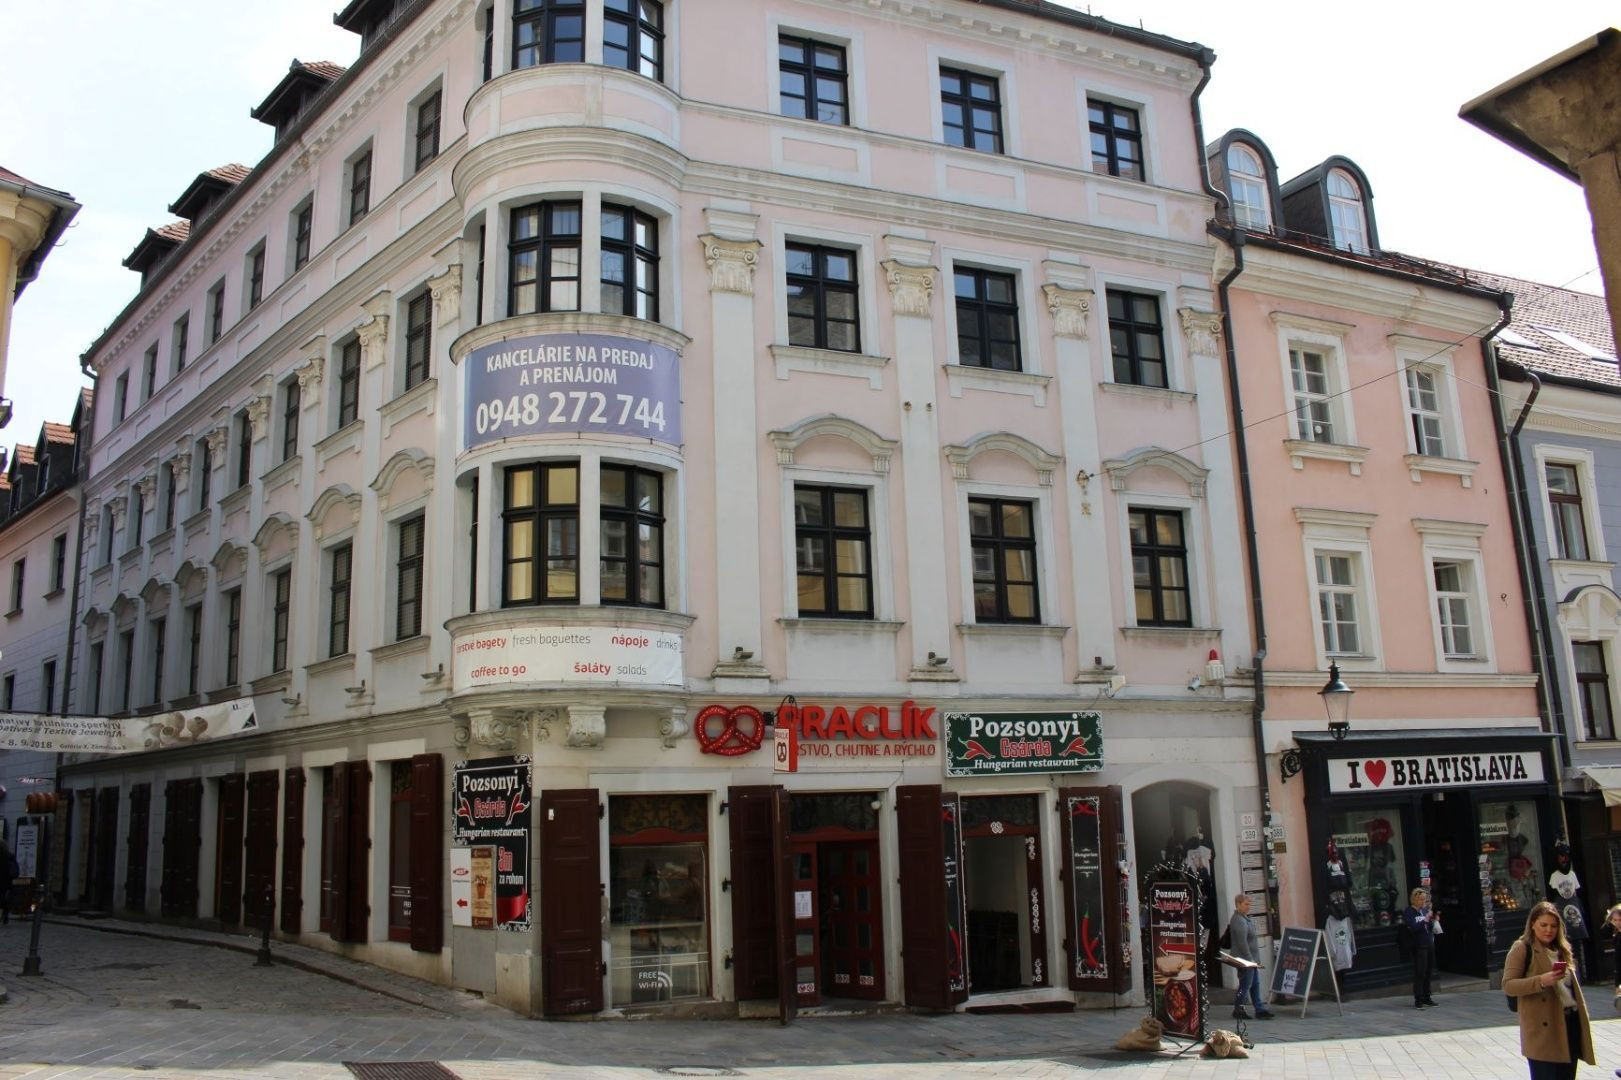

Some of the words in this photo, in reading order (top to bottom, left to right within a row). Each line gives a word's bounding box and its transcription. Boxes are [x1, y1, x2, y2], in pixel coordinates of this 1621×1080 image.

[487, 344, 571, 372] KANCELÁRIE
[575, 347, 598, 363] NA
[601, 347, 654, 370] PREDAJ
[520, 370, 530, 386] A
[533, 363, 617, 385] PRENÁJOM
[476, 393, 540, 435] 0948
[548, 391, 608, 424] 272
[616, 394, 667, 432] 744
[476, 637, 508, 650] bagety
[512, 634, 537, 648] fresh
[539, 633, 591, 647] baguettes
[611, 634, 649, 649] nápoje
[656, 640, 678, 651] drinks
[471, 666, 497, 679] coffee
[499, 666, 509, 675] to
[512, 665, 527, 677] go
[574, 661, 612, 676] šaláty
[617, 664, 648, 676] salads
[969, 713, 1081, 743] Pozsonyi
[836, 744, 881, 756] CHUTNE
[883, 744, 892, 756] A
[1001, 737, 1052, 758] Csárda
[974, 759, 1027, 772] Hungarian
[1028, 758, 1079, 768] restaurant
[1347, 761, 1362, 789] I
[1391, 755, 1528, 786] BRATISLAVA
[462, 768, 519, 796] Pozsonyi
[474, 797, 506, 819] Csárda
[459, 827, 491, 840] Hungarian
[491, 827, 525, 837] restaurant
[1155, 889, 1188, 901] Pozsonyi
[638, 971, 657, 979] FREE
